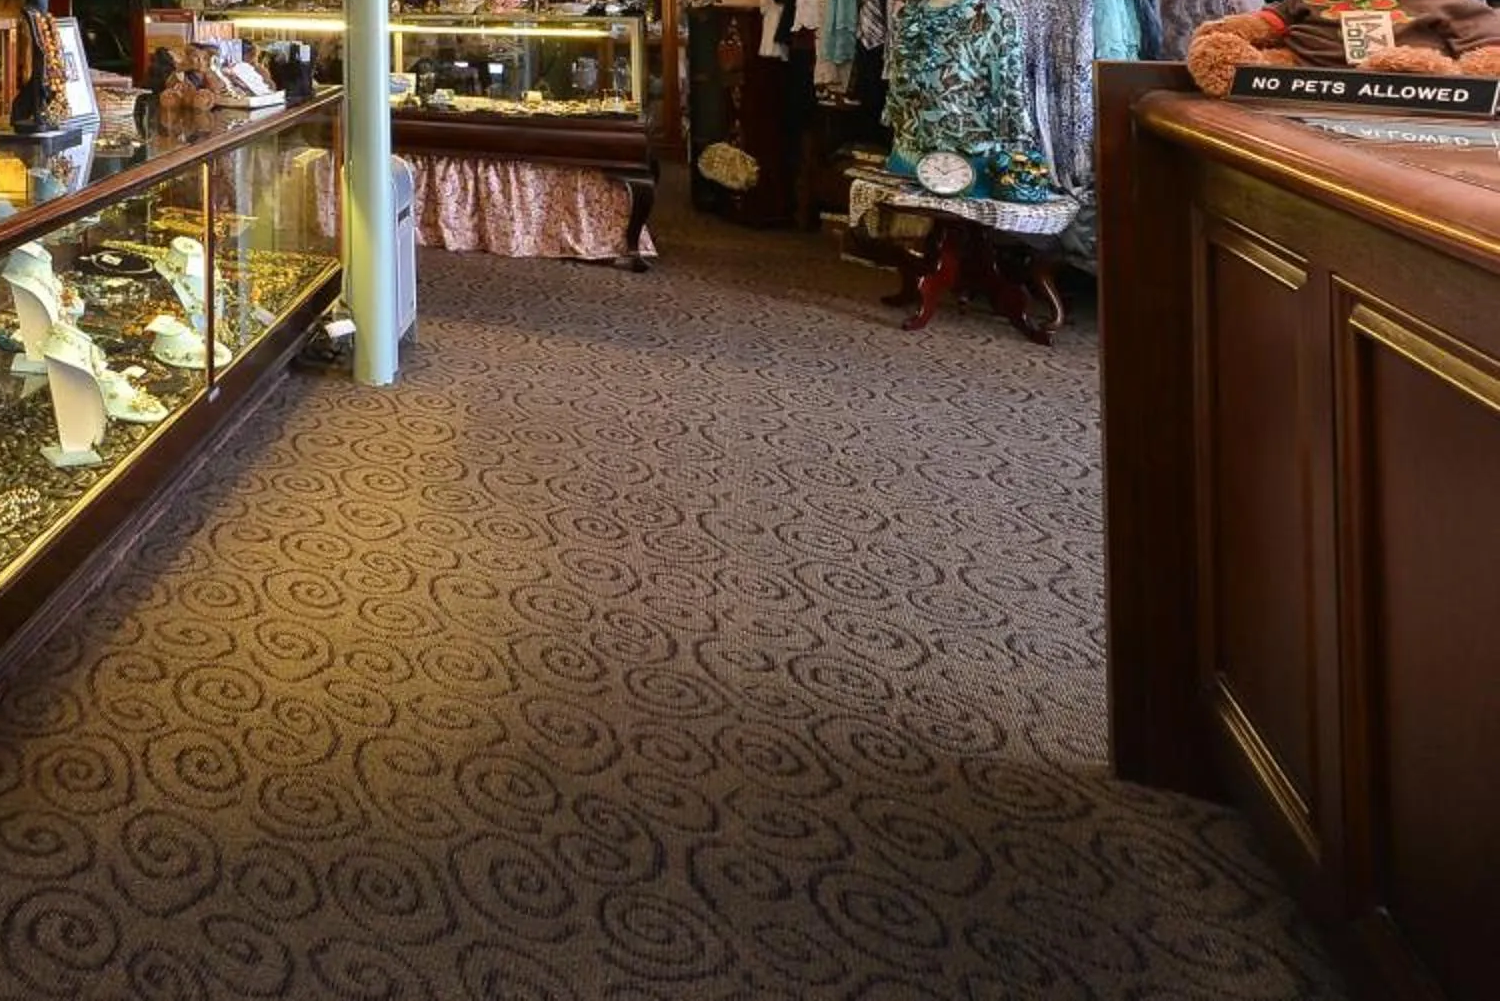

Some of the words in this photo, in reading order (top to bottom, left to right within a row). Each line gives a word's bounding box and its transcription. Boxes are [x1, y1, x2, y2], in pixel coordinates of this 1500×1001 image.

[1251, 76, 1280, 91] NO
[1291, 79, 1345, 95] PETS
[1358, 84, 1469, 103] ALLOWED
